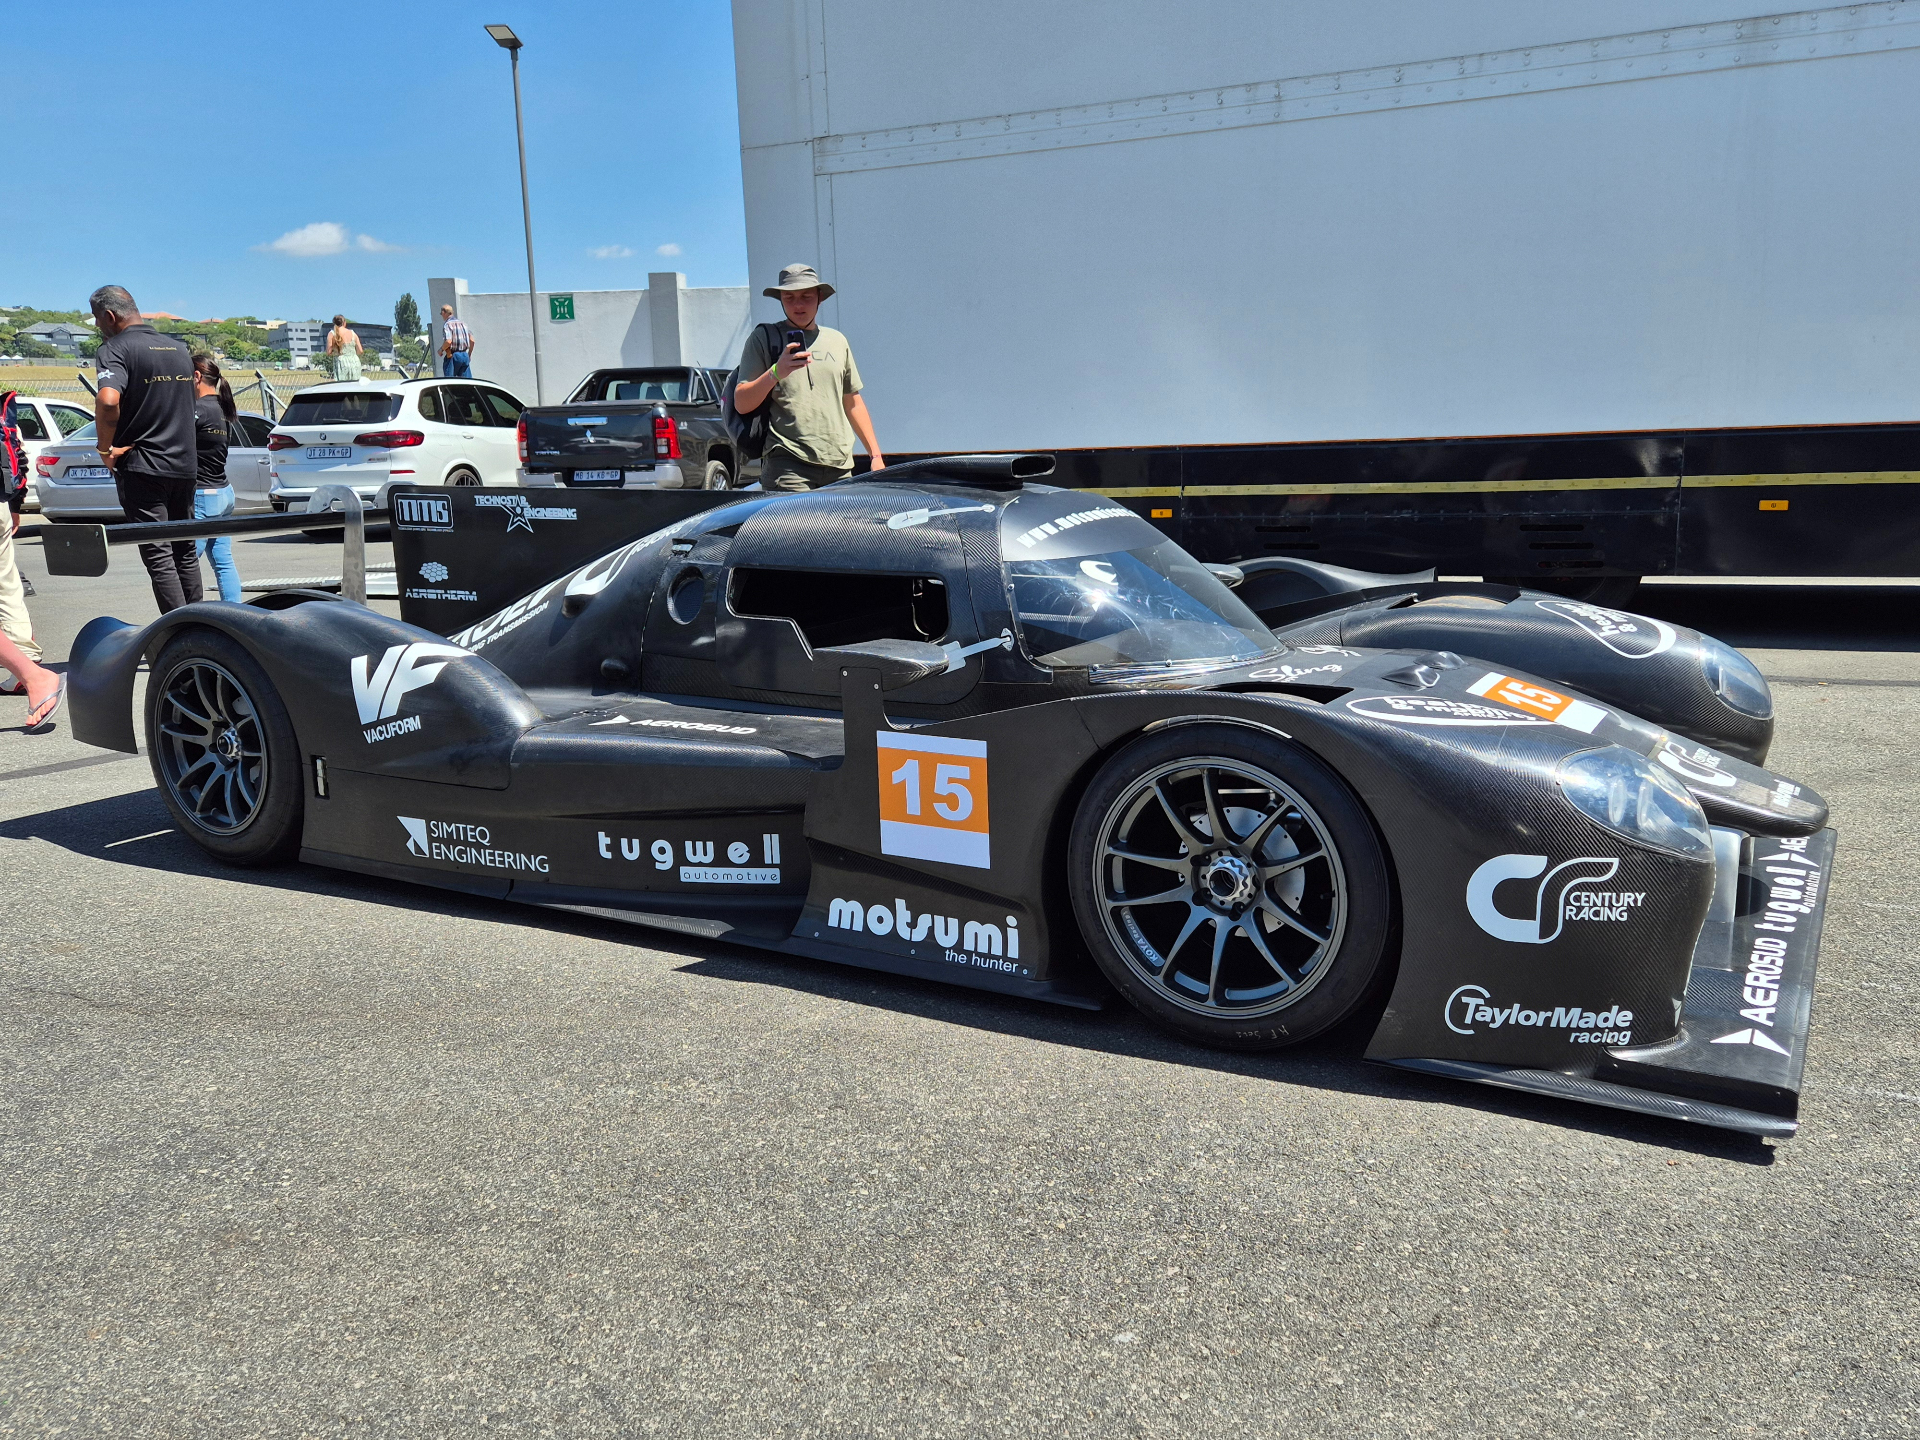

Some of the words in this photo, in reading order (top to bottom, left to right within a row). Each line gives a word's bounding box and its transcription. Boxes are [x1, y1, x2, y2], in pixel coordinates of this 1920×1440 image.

[144, 375, 172, 384] LOTUS
[340, 448, 349, 457] GP
[524, 507, 577, 519] ENGINEERING
[405, 588, 478, 602] AEROTHERM
[486, 600, 550, 645] TRANSMISSION
[1248, 664, 1343, 682] Sling
[1497, 681, 1562, 712] 15
[363, 715, 422, 744] VACUFORM
[629, 719, 757, 735] AEROSUD
[891, 758, 973, 822] 15
[430, 820, 491, 846] SIMTEQ
[432, 843, 550, 873] ENGINEERING
[597, 831, 781, 871] tugwell
[683, 871, 778, 881] automotive
[1569, 891, 1647, 907] CENTURY
[1565, 906, 1629, 922] RACING
[827, 897, 1020, 960] motsumi
[944, 949, 968, 964] the
[971, 953, 1020, 973] hunter
[1739, 937, 1788, 1027] AEROSUD
[1461, 996, 1634, 1029] TaylorMade
[1569, 1028, 1632, 1046] racing
